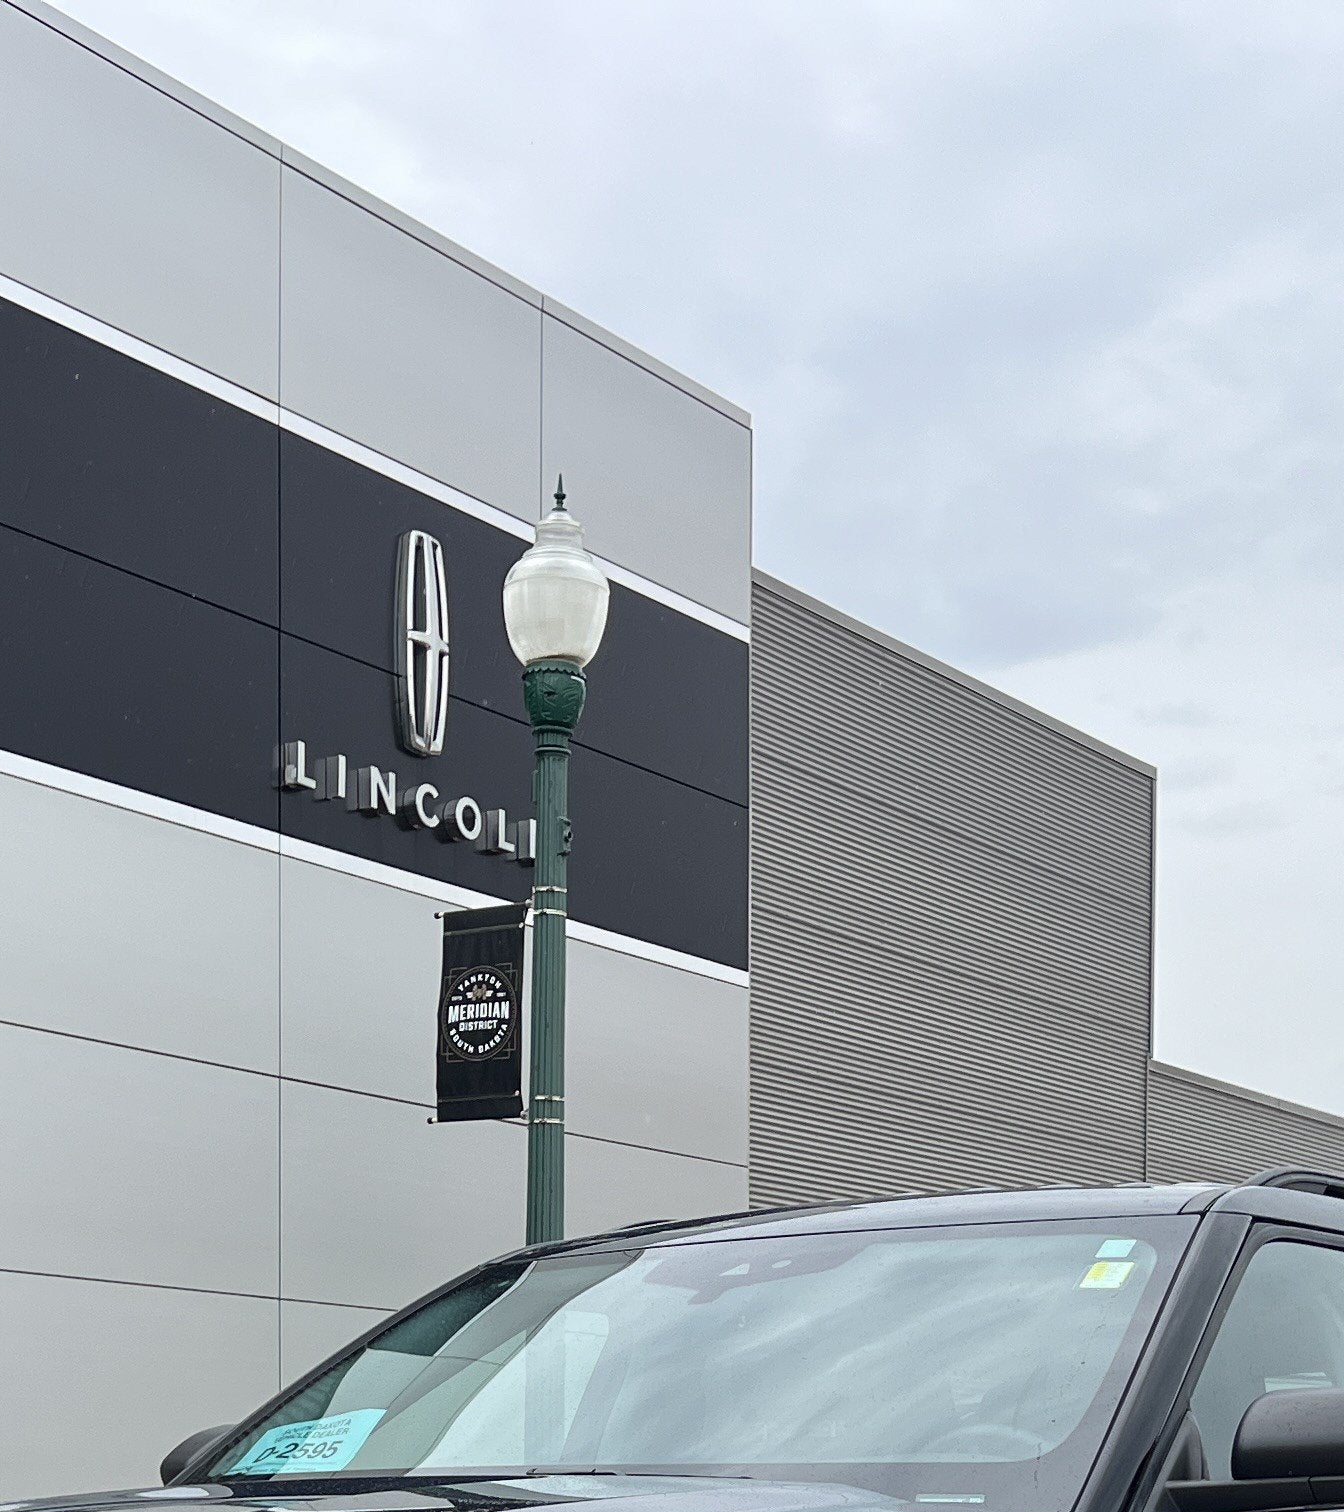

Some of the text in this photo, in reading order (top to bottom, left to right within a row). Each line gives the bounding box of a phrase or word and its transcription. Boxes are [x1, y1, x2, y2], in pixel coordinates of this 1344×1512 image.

[458, 973, 501, 991] YANKTON
[448, 1001, 509, 1024] MERIDIAN
[458, 1019, 498, 1031] DISTRICT
[449, 1024, 507, 1053] SOUTH DAKOTA
[312, 1427, 350, 1439] DEALER
[315, 1418, 352, 1430] DAKOTA
[252, 1440, 344, 1464] D-2595
